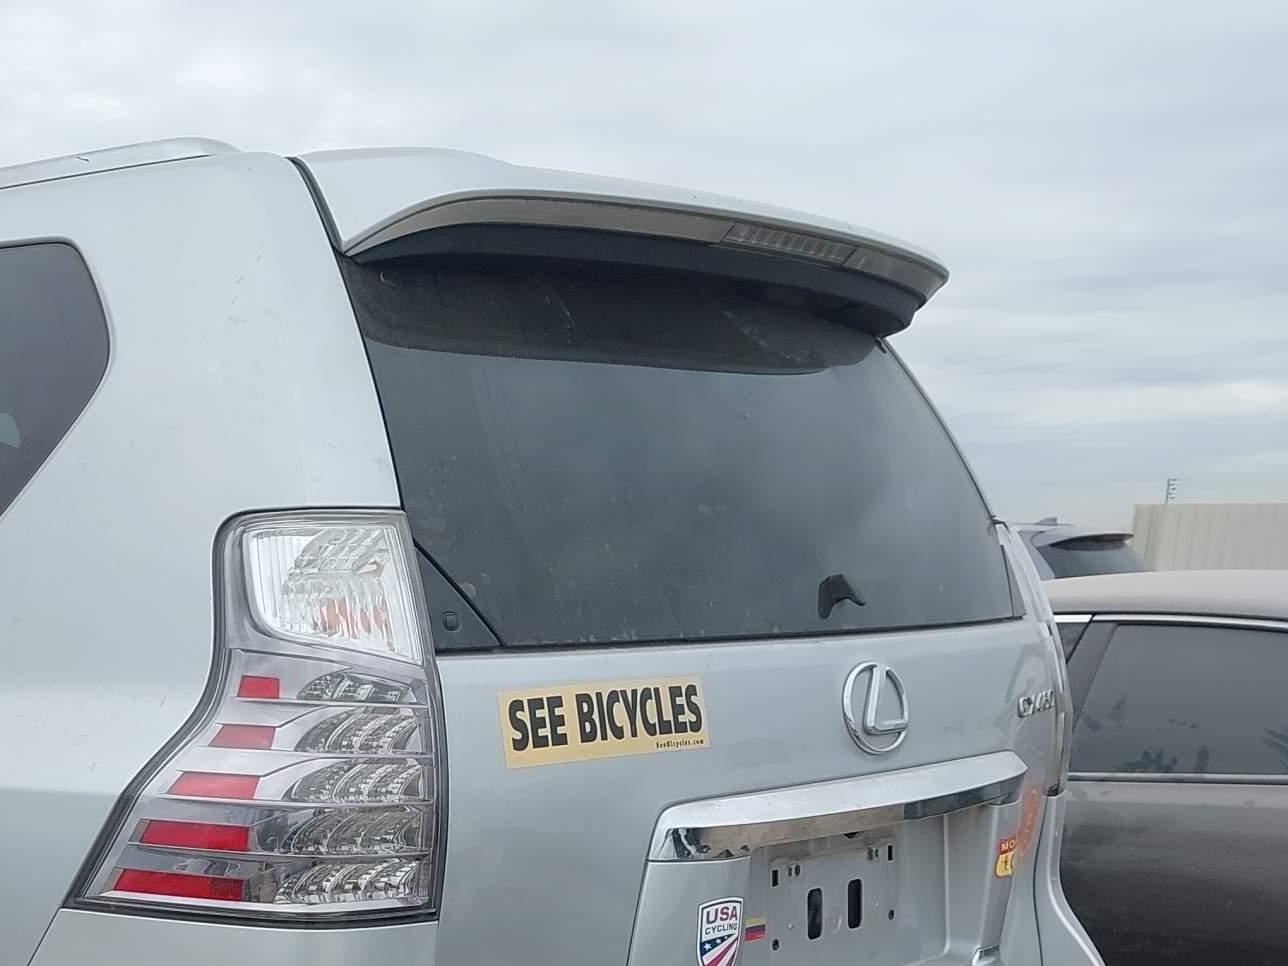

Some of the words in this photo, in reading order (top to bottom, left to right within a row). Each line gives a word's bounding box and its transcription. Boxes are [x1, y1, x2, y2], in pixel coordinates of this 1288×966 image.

[508, 695, 568, 751] SEE
[575, 684, 703, 743] BICYCLES
[706, 906, 738, 924] USA
[705, 922, 738, 935] CYCLING
